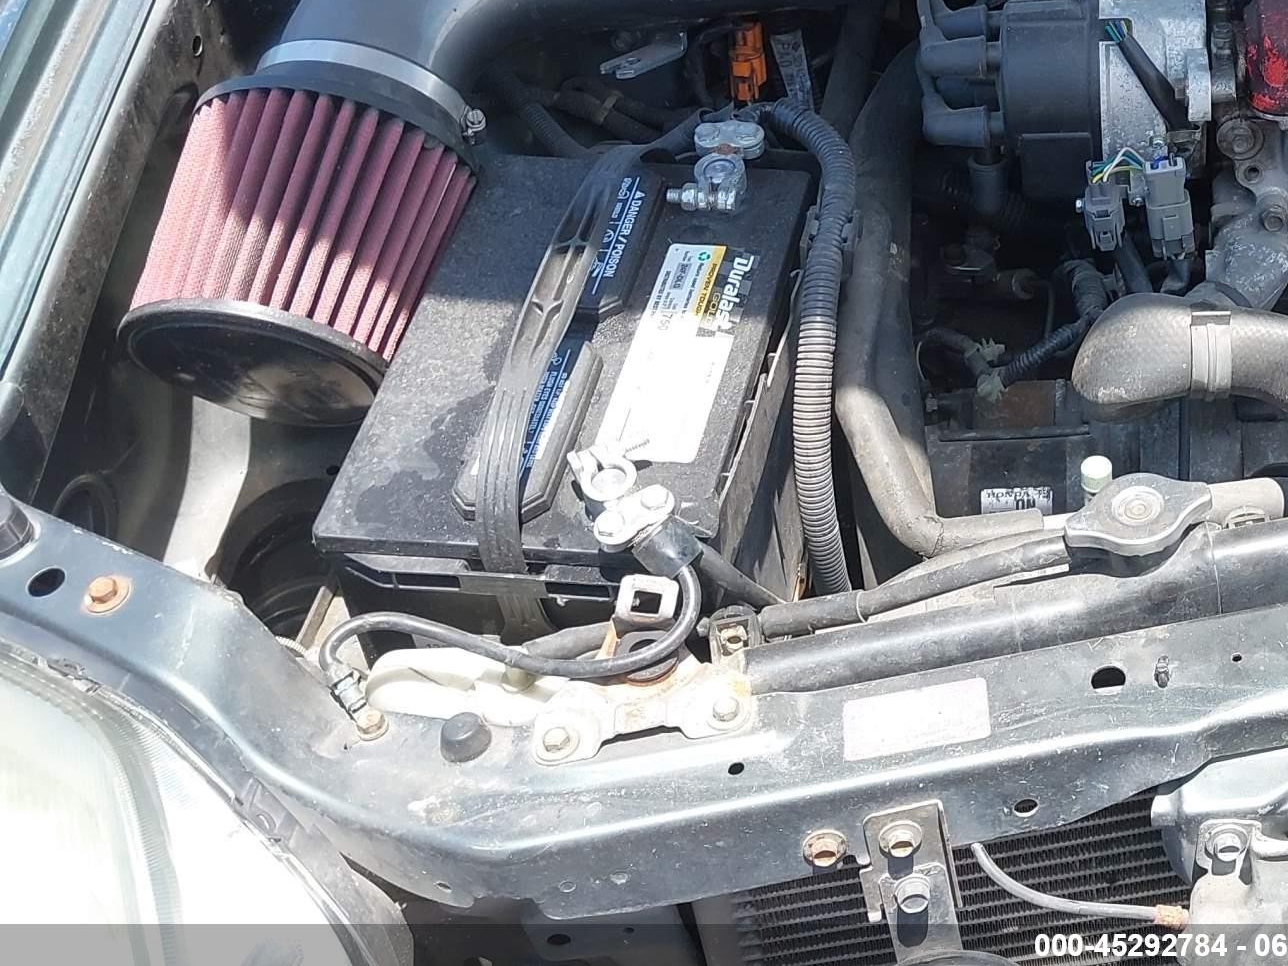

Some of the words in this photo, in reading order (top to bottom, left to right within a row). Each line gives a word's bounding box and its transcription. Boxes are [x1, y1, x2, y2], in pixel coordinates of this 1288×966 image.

[620, 199, 642, 235] DANGER
[603, 243, 624, 278] POISON
[702, 263, 717, 291] PROVEN
[711, 254, 755, 332] Duralast
